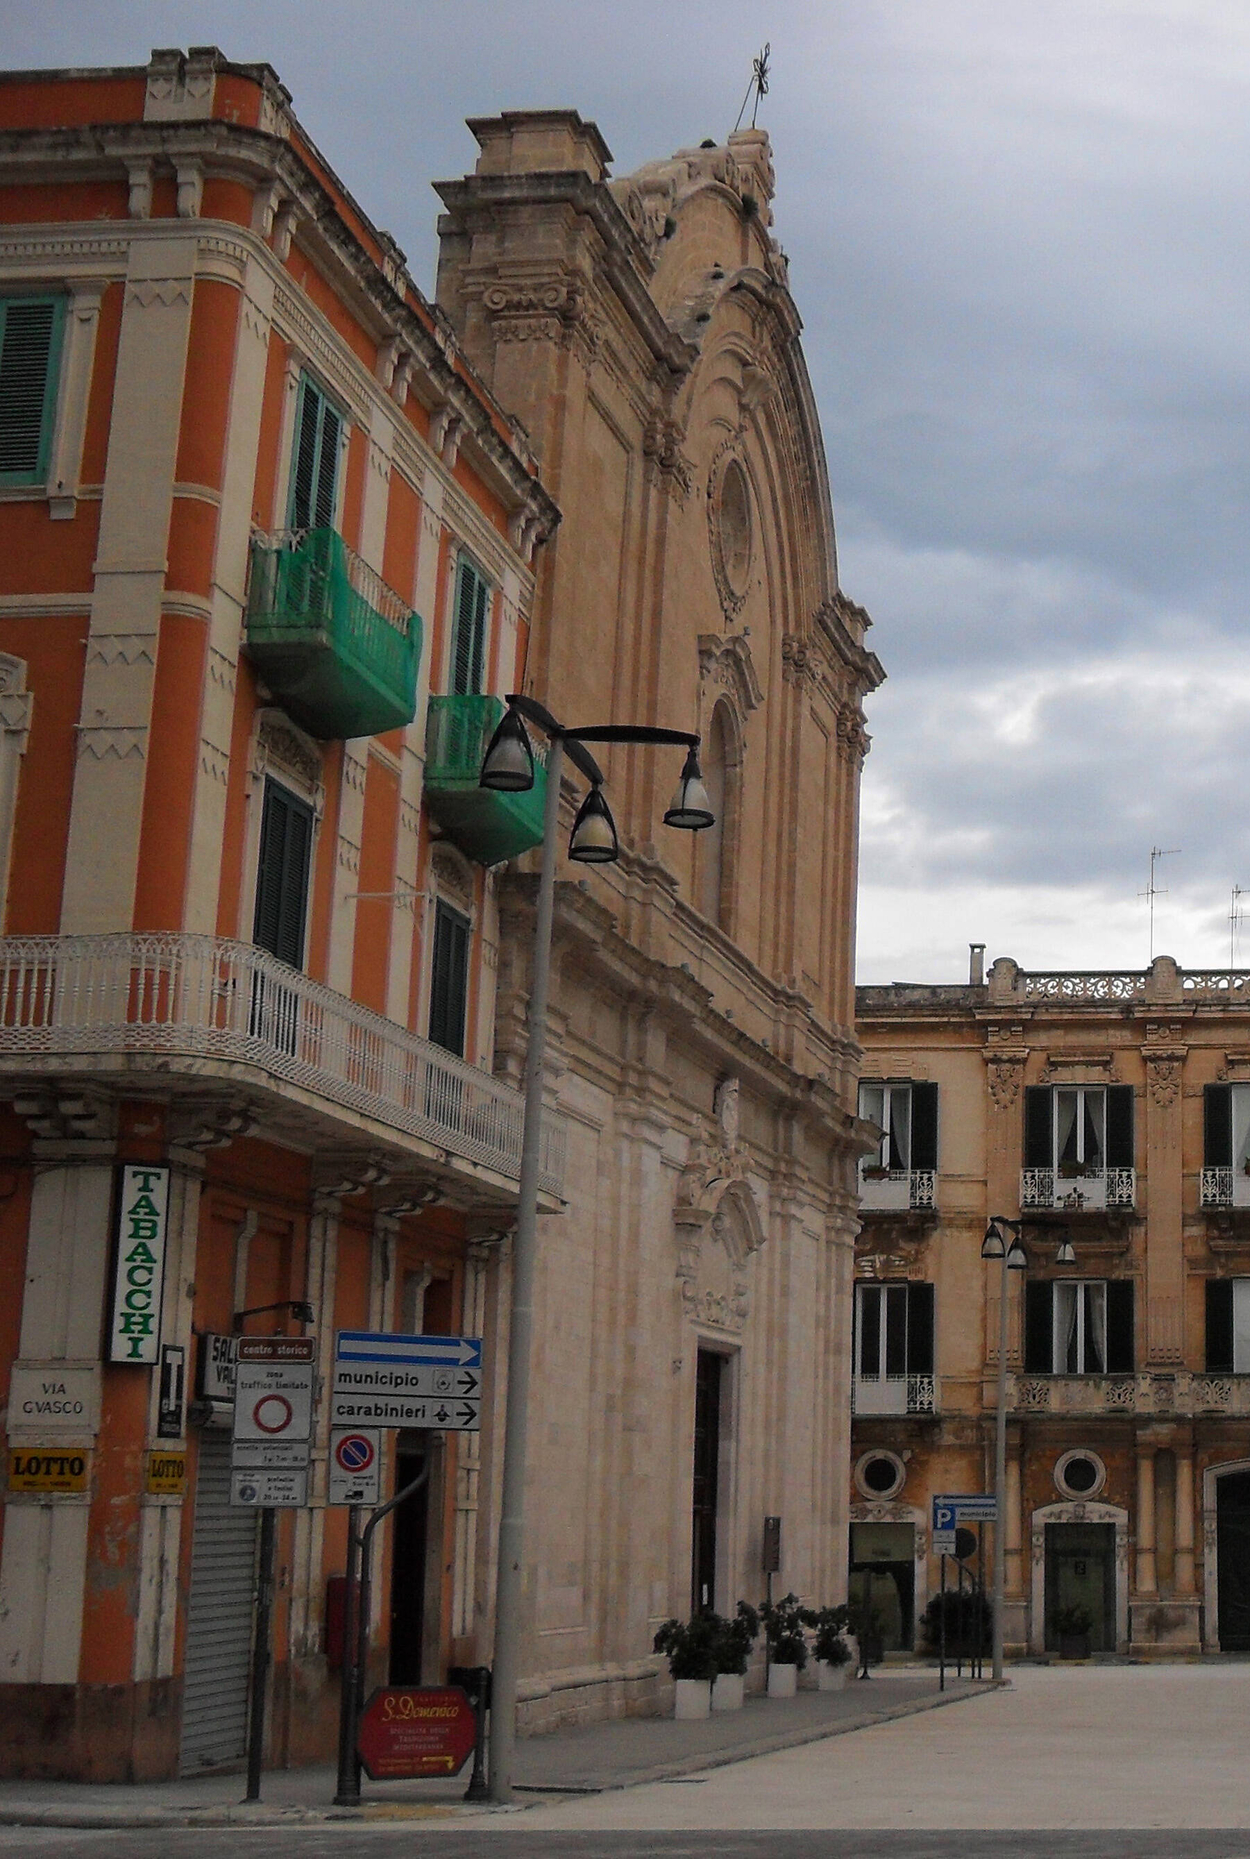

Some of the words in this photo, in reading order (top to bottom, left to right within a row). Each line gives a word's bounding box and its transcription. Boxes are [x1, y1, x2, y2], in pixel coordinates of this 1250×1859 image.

[118, 1170, 161, 1358] TABACCHI
[243, 1344, 274, 1355] centro
[277, 1344, 309, 1355] storico
[241, 1381, 272, 1390] traffico
[338, 1370, 419, 1388] municipio
[42, 1383, 67, 1395] VIA
[23, 1401, 84, 1415] GVASCO
[336, 1403, 426, 1418] carabinieri
[13, 1456, 84, 1476] LOTTO
[152, 1459, 184, 1478] LOTTO
[937, 1508, 952, 1529] P
[959, 1510, 996, 1518] municipio
